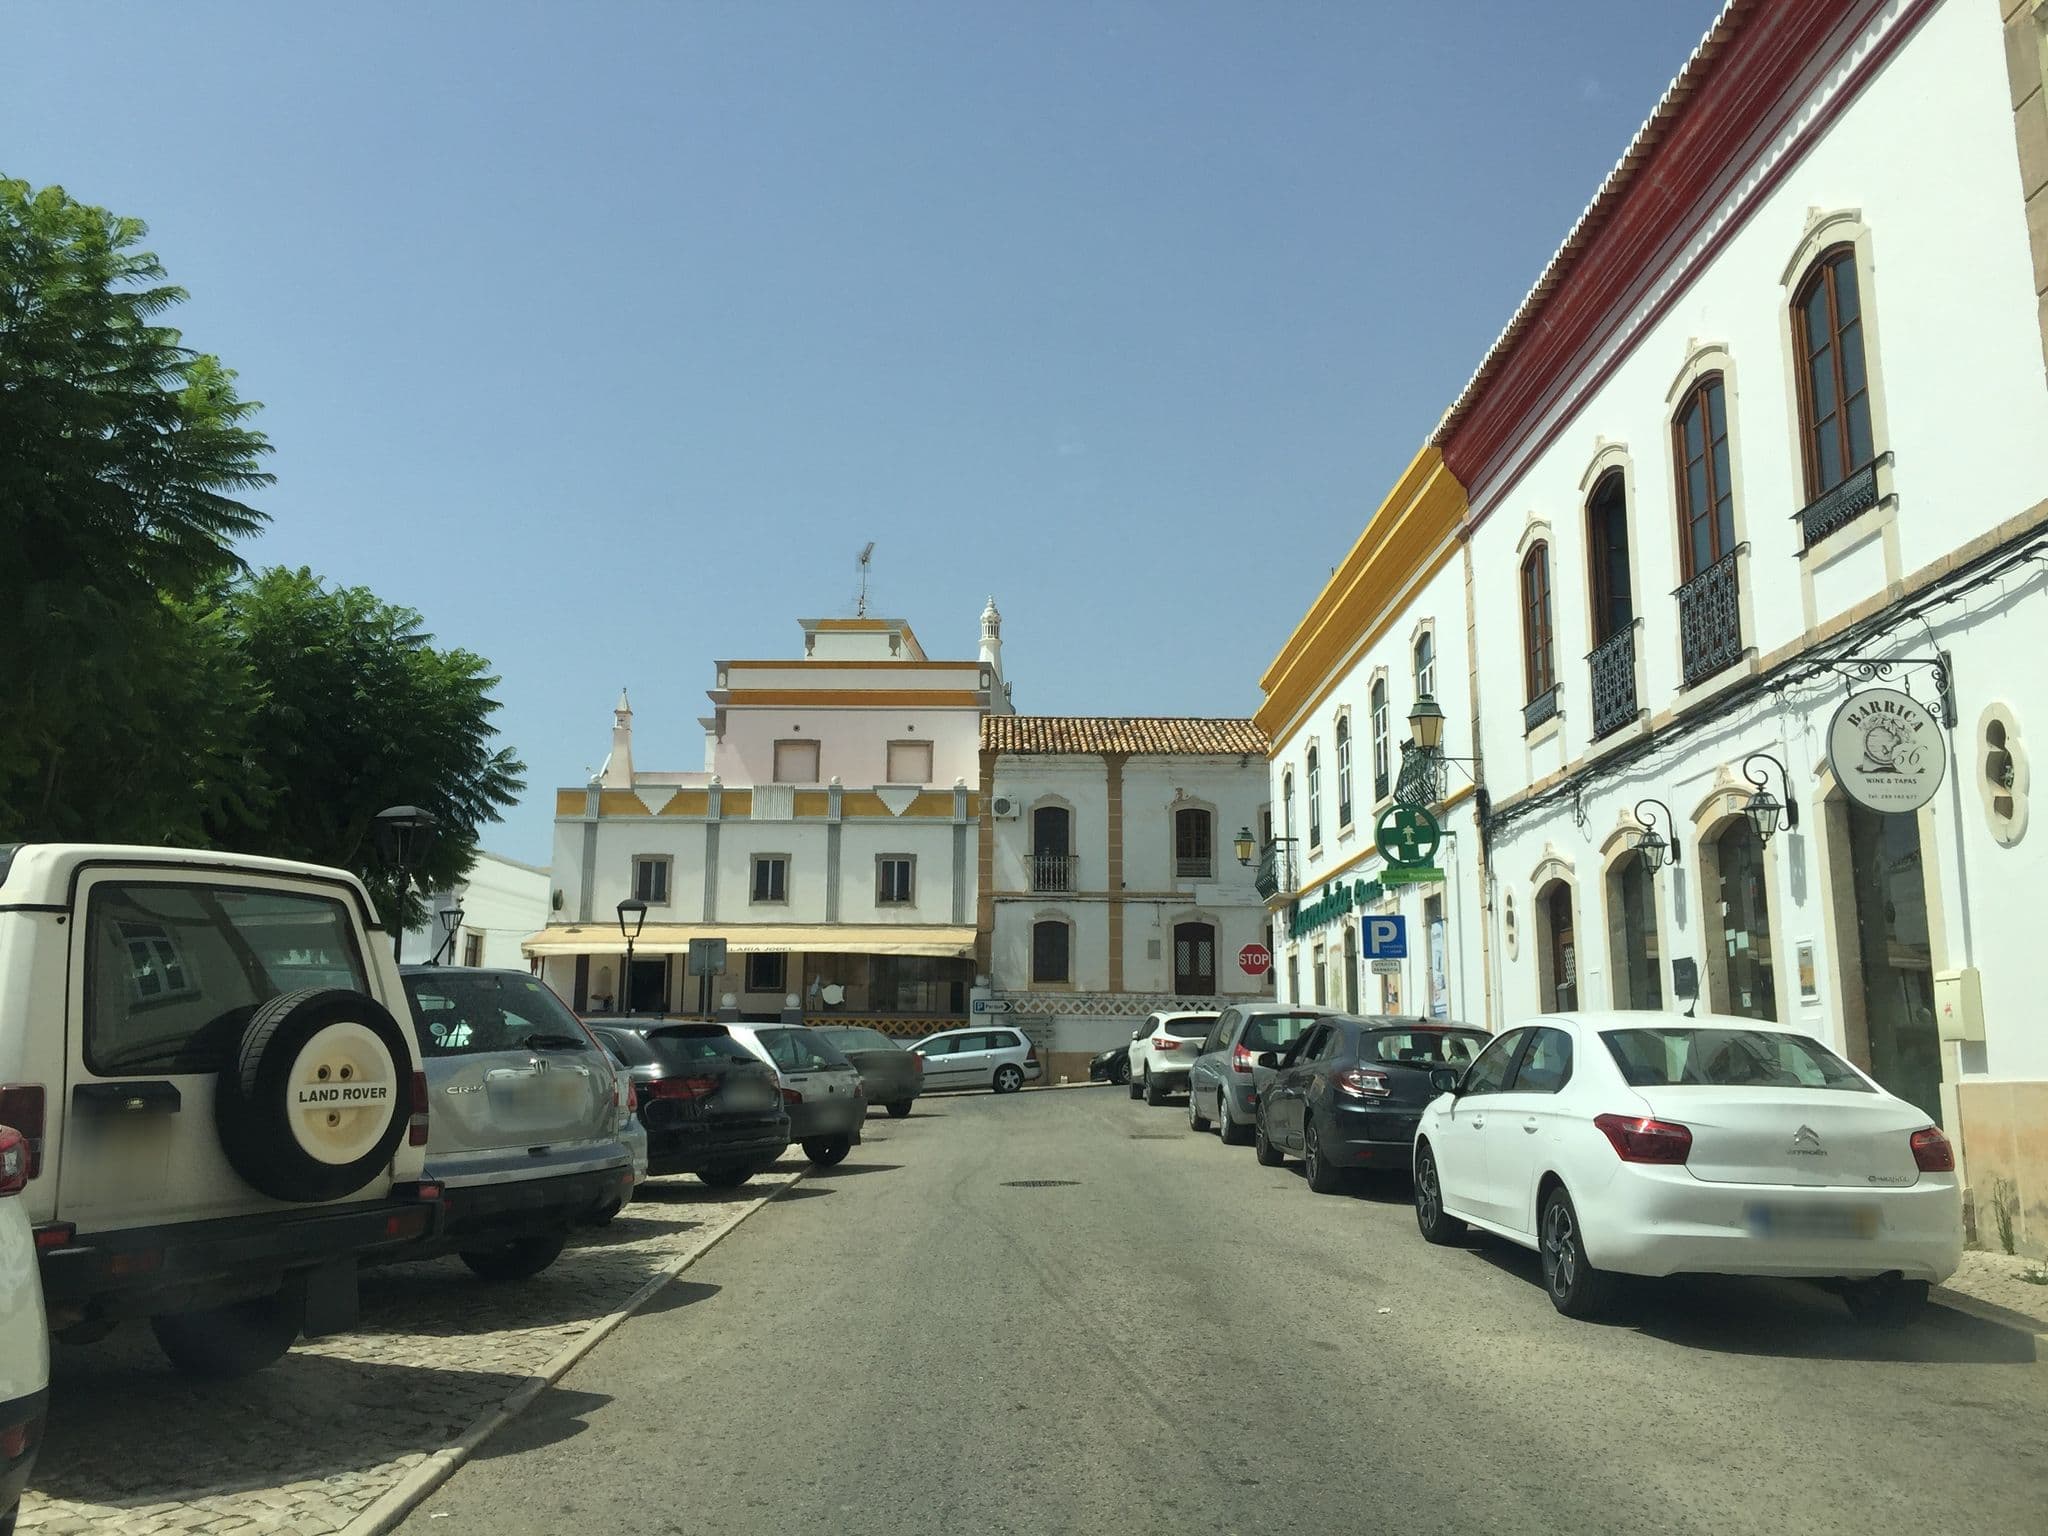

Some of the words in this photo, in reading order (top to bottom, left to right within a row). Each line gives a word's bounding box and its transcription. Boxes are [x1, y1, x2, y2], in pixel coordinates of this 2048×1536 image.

[1847, 701, 1924, 732] BARRICA
[1371, 920, 1398, 954] P
[1240, 953, 1269, 965] STOP
[299, 1089, 339, 1103] LAND
[343, 1088, 387, 1100] ROVER
